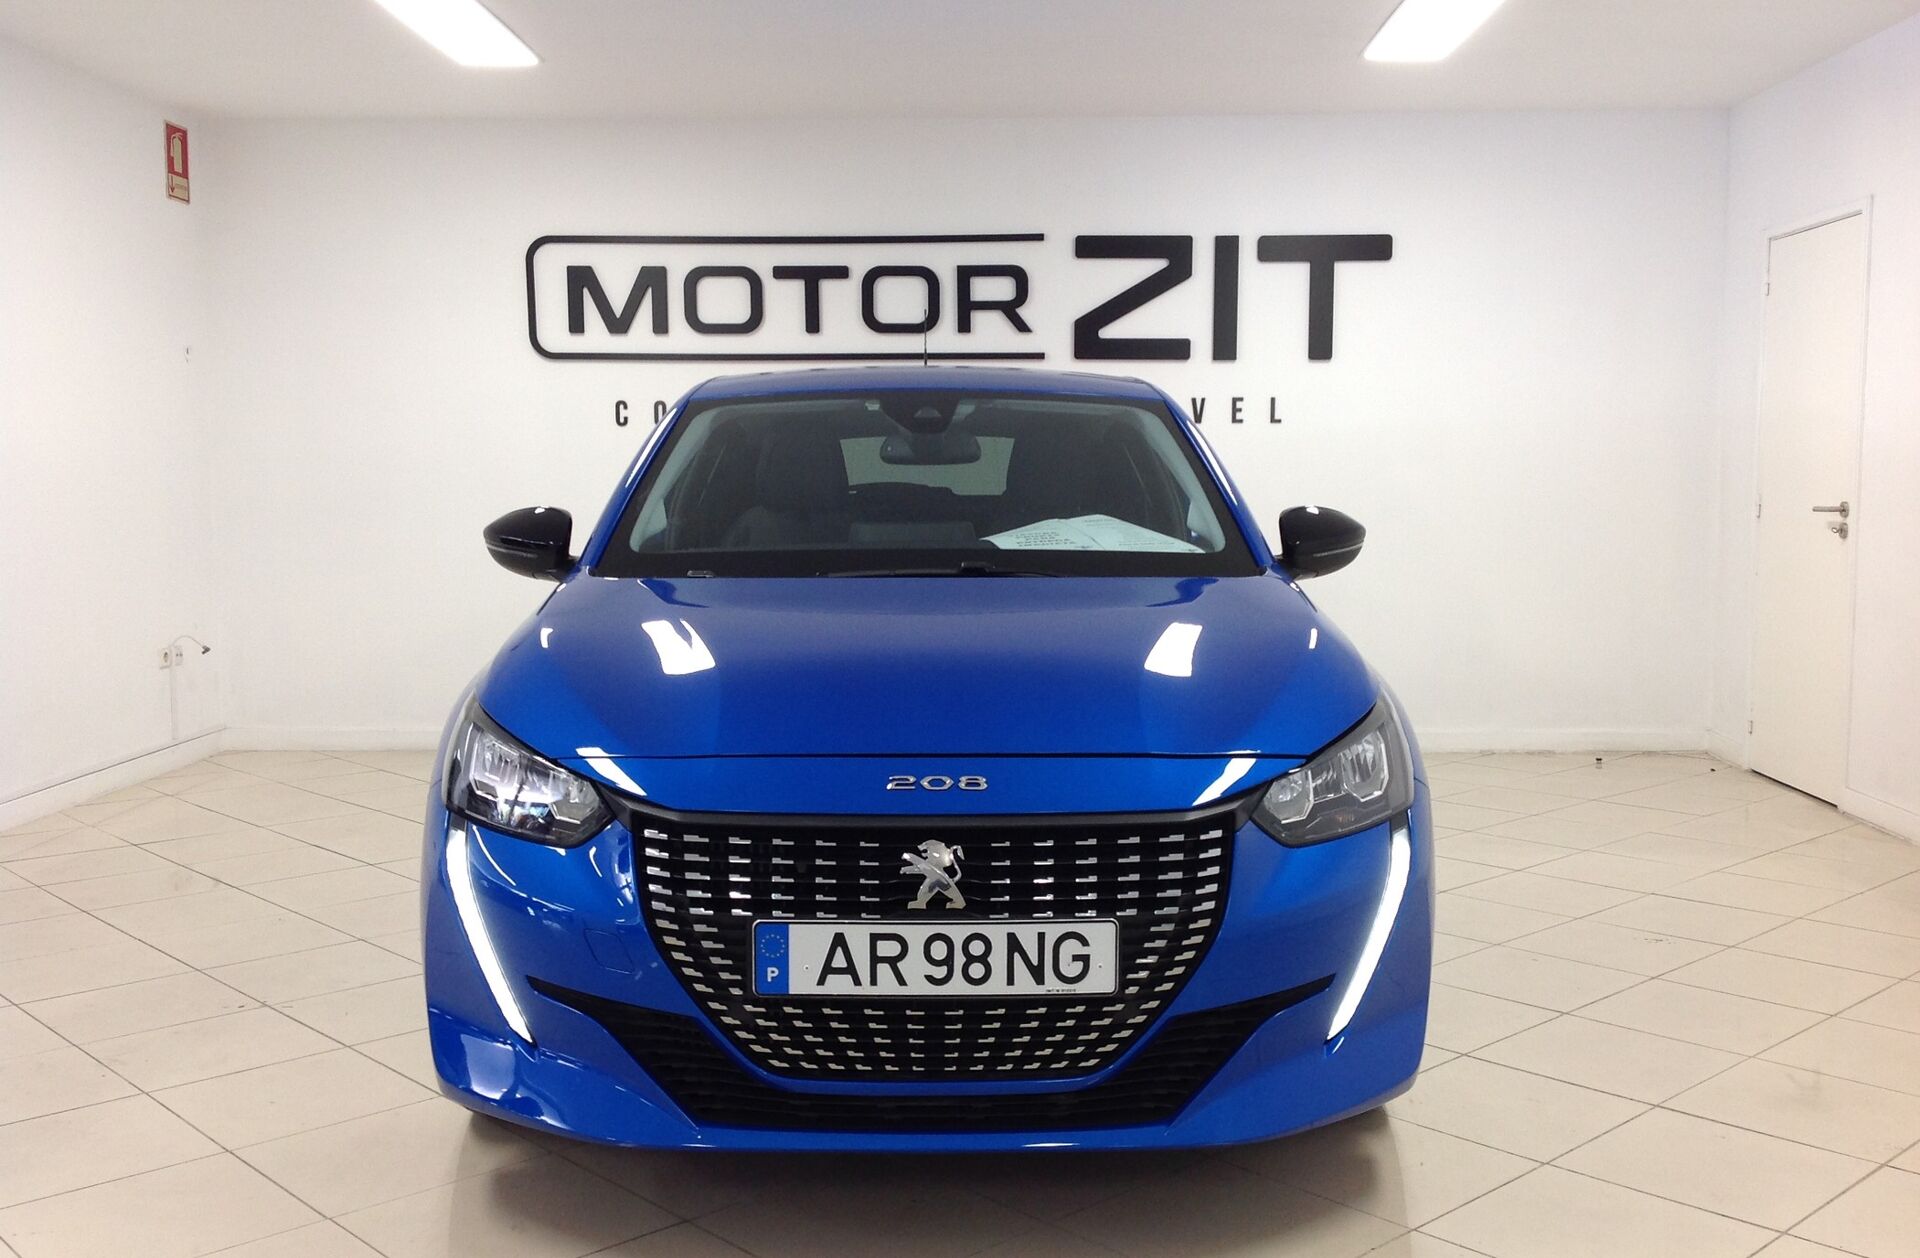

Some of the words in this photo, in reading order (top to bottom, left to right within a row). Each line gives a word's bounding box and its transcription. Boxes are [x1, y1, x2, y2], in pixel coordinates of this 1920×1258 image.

[566, 264, 1033, 335] MOTOR
[1073, 234, 1393, 361] ZIT
[886, 775, 988, 790] 208
[766, 966, 779, 983] P
